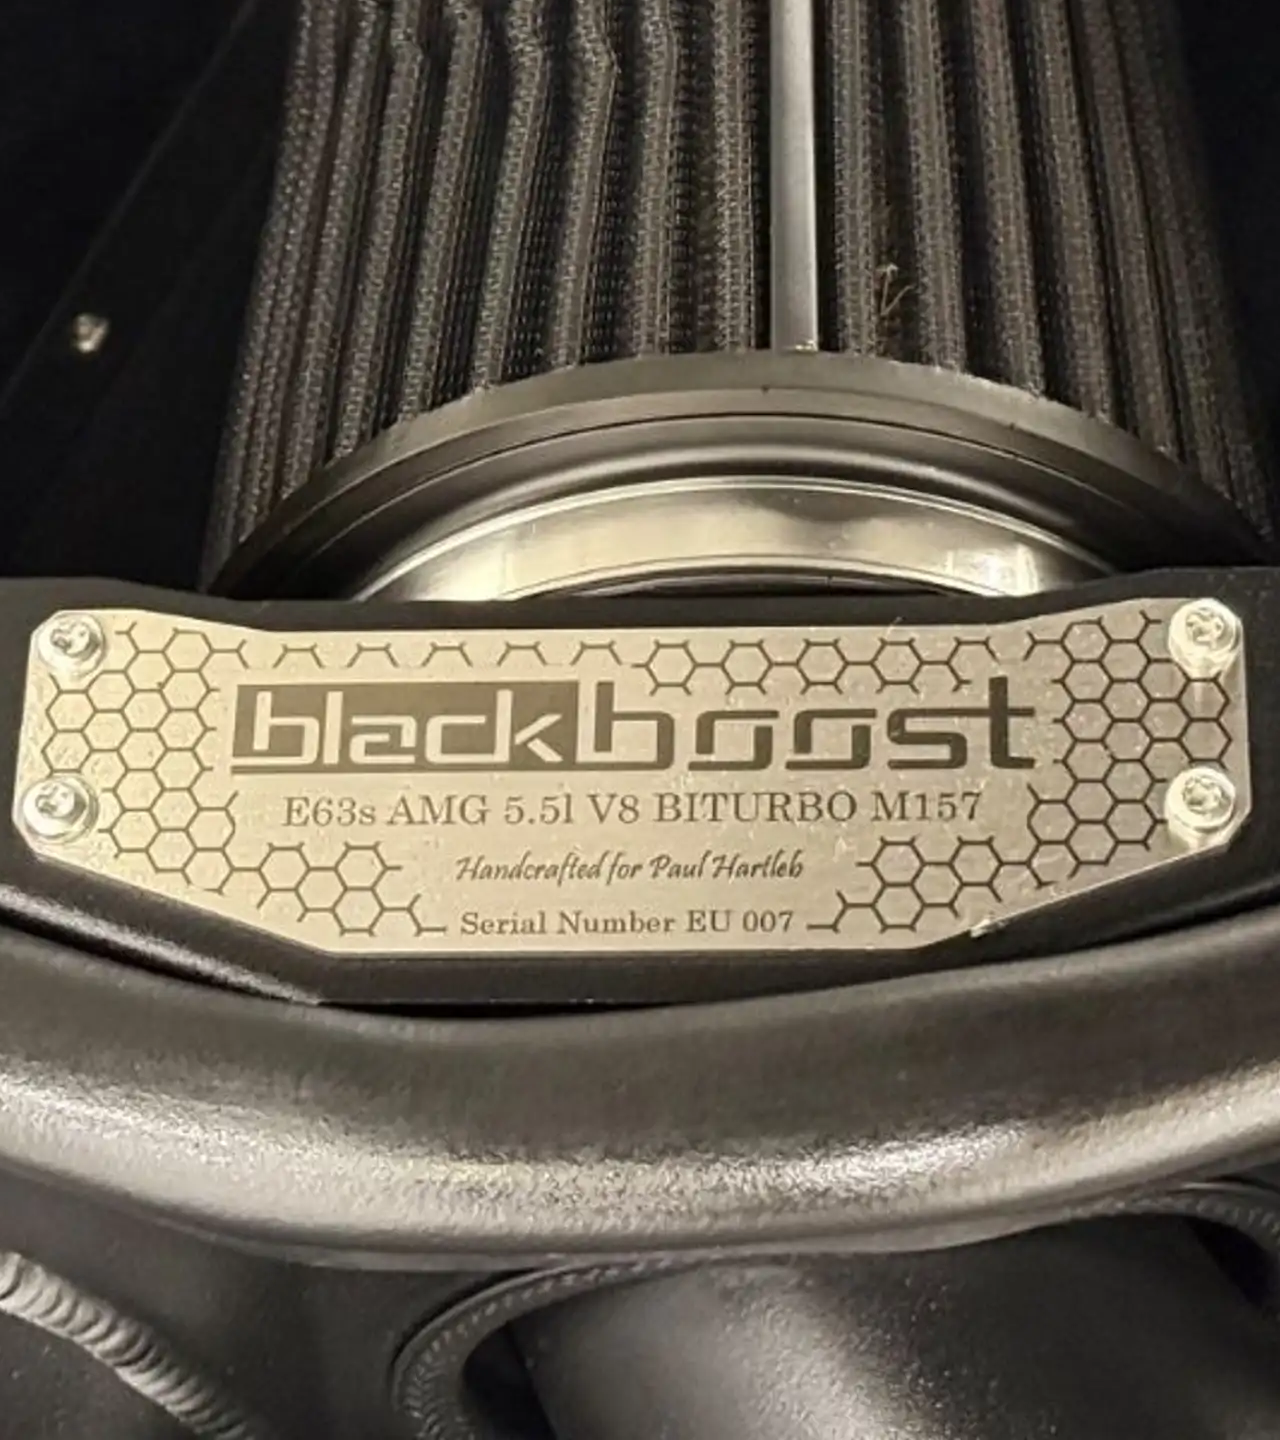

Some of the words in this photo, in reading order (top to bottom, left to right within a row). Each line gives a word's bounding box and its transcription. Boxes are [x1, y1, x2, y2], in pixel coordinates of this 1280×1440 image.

[282, 796, 377, 827] E63s
[386, 794, 491, 826] AMG
[587, 793, 639, 824] V8
[653, 791, 858, 824] BITURBO
[870, 791, 983, 823] M157
[455, 850, 604, 887] Handcrafted
[604, 850, 643, 887] for
[649, 850, 705, 880] Paul
[711, 850, 804, 880] Hartleb
[459, 911, 547, 936] Serial
[557, 910, 675, 936] Number
[686, 910, 732, 934] EU
[742, 910, 794, 934] 007
